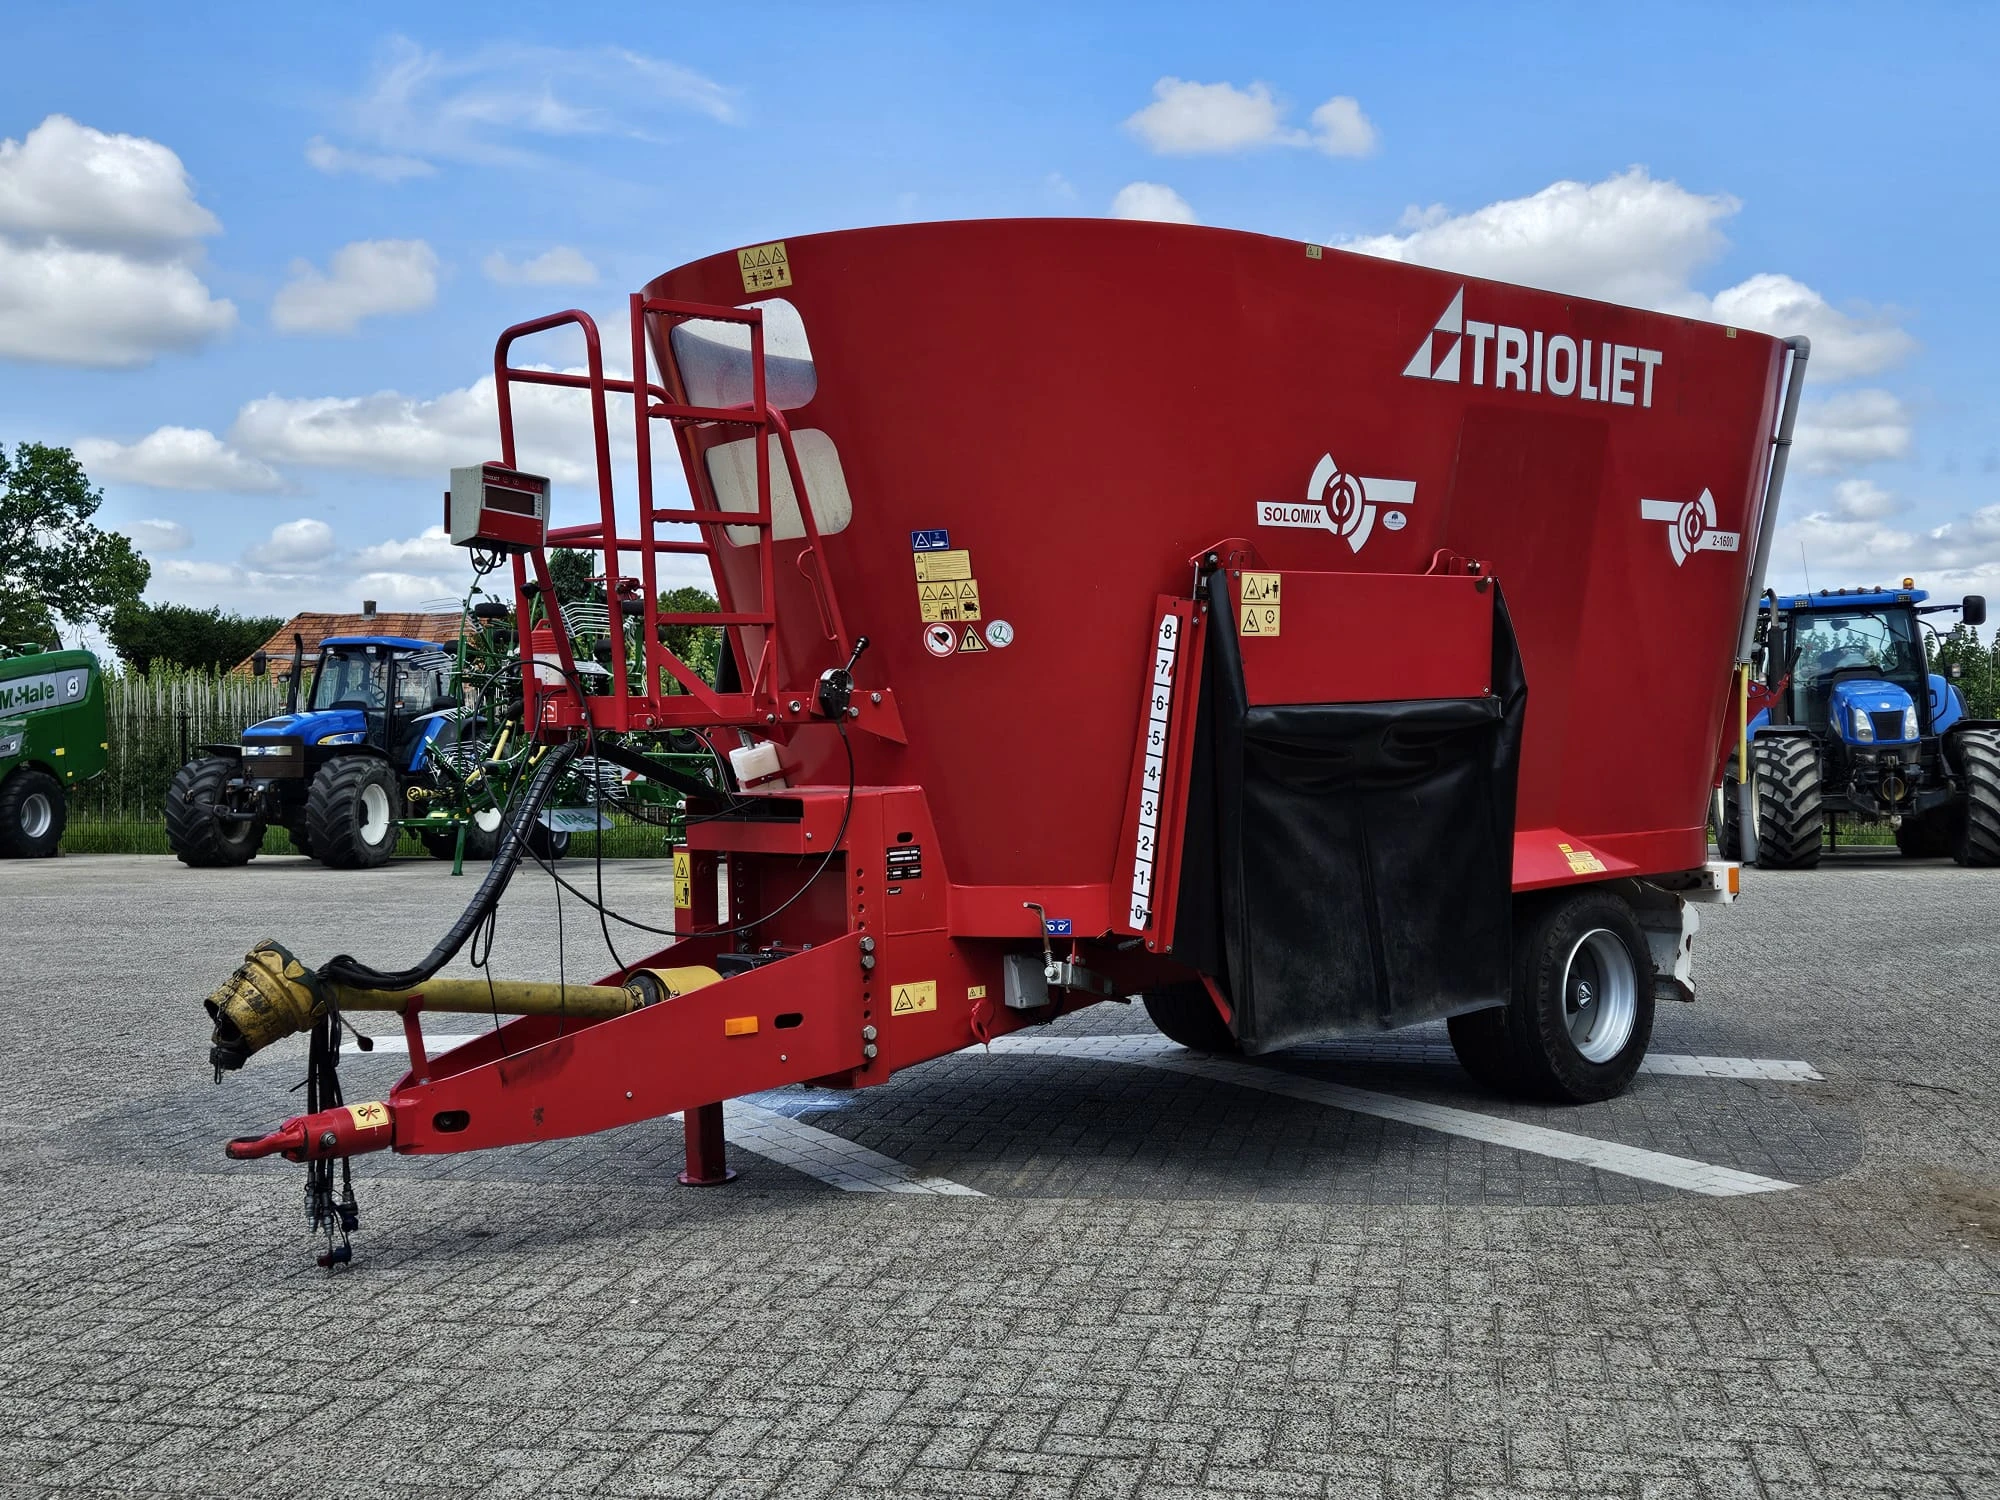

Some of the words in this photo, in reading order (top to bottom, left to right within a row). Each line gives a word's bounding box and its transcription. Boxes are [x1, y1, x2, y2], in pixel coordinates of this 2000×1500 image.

[1466, 319, 1663, 408] TRIOLIET
[1263, 506, 1321, 524] SOLOMIX
[1163, 624, 1172, 639] 8
[1160, 660, 1169, 674] 7
[1156, 695, 1164, 711] 6
[1152, 730, 1160, 746] 5
[1148, 766, 1156, 781] 4
[1144, 800, 1153, 816] 3
[1141, 835, 1149, 851] 2
[1139, 870, 1145, 885] 1
[1134, 905, 1143, 920] 0
